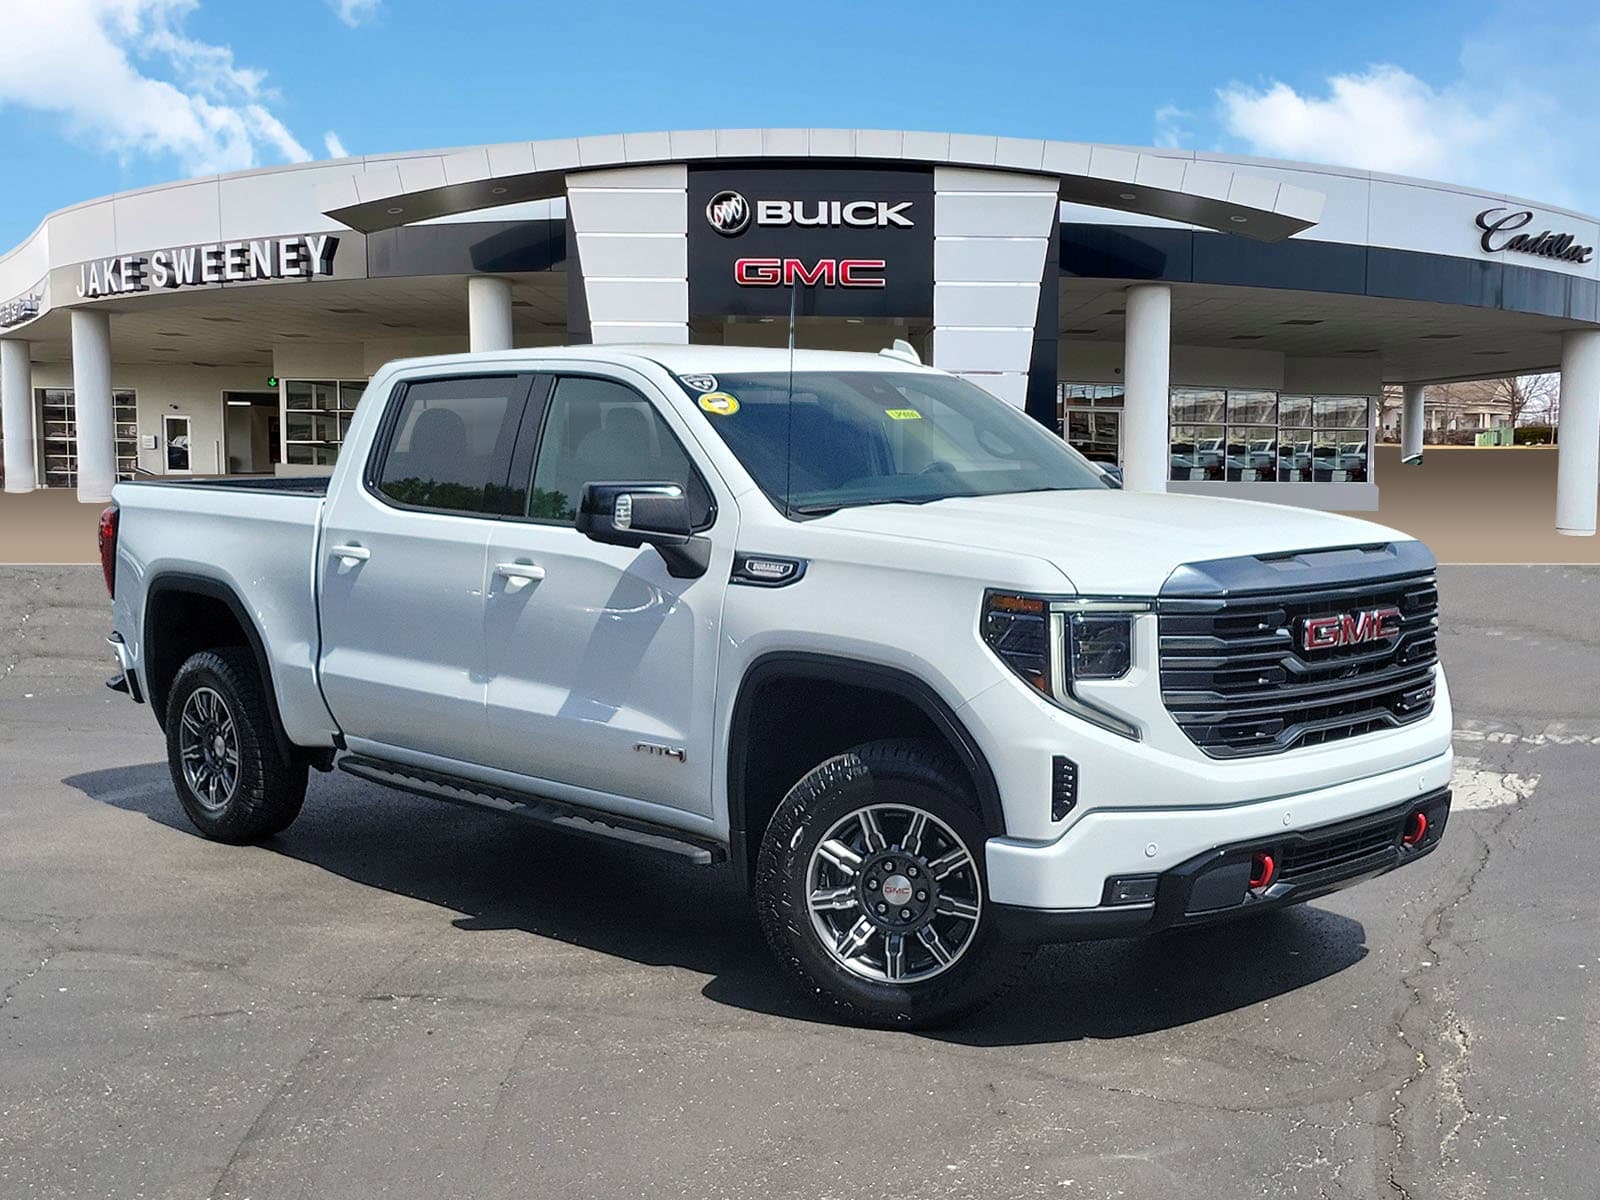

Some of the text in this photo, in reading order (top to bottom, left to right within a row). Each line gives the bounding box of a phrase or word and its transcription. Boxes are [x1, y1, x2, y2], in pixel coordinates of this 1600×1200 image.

[757, 200, 914, 226] BUICK
[1475, 207, 1593, 263] Cadillac
[76, 235, 333, 298] JAKE SWEENEY
[735, 258, 886, 286] GMC
[1302, 607, 1401, 651] GMC
[884, 886, 910, 894] GMC
